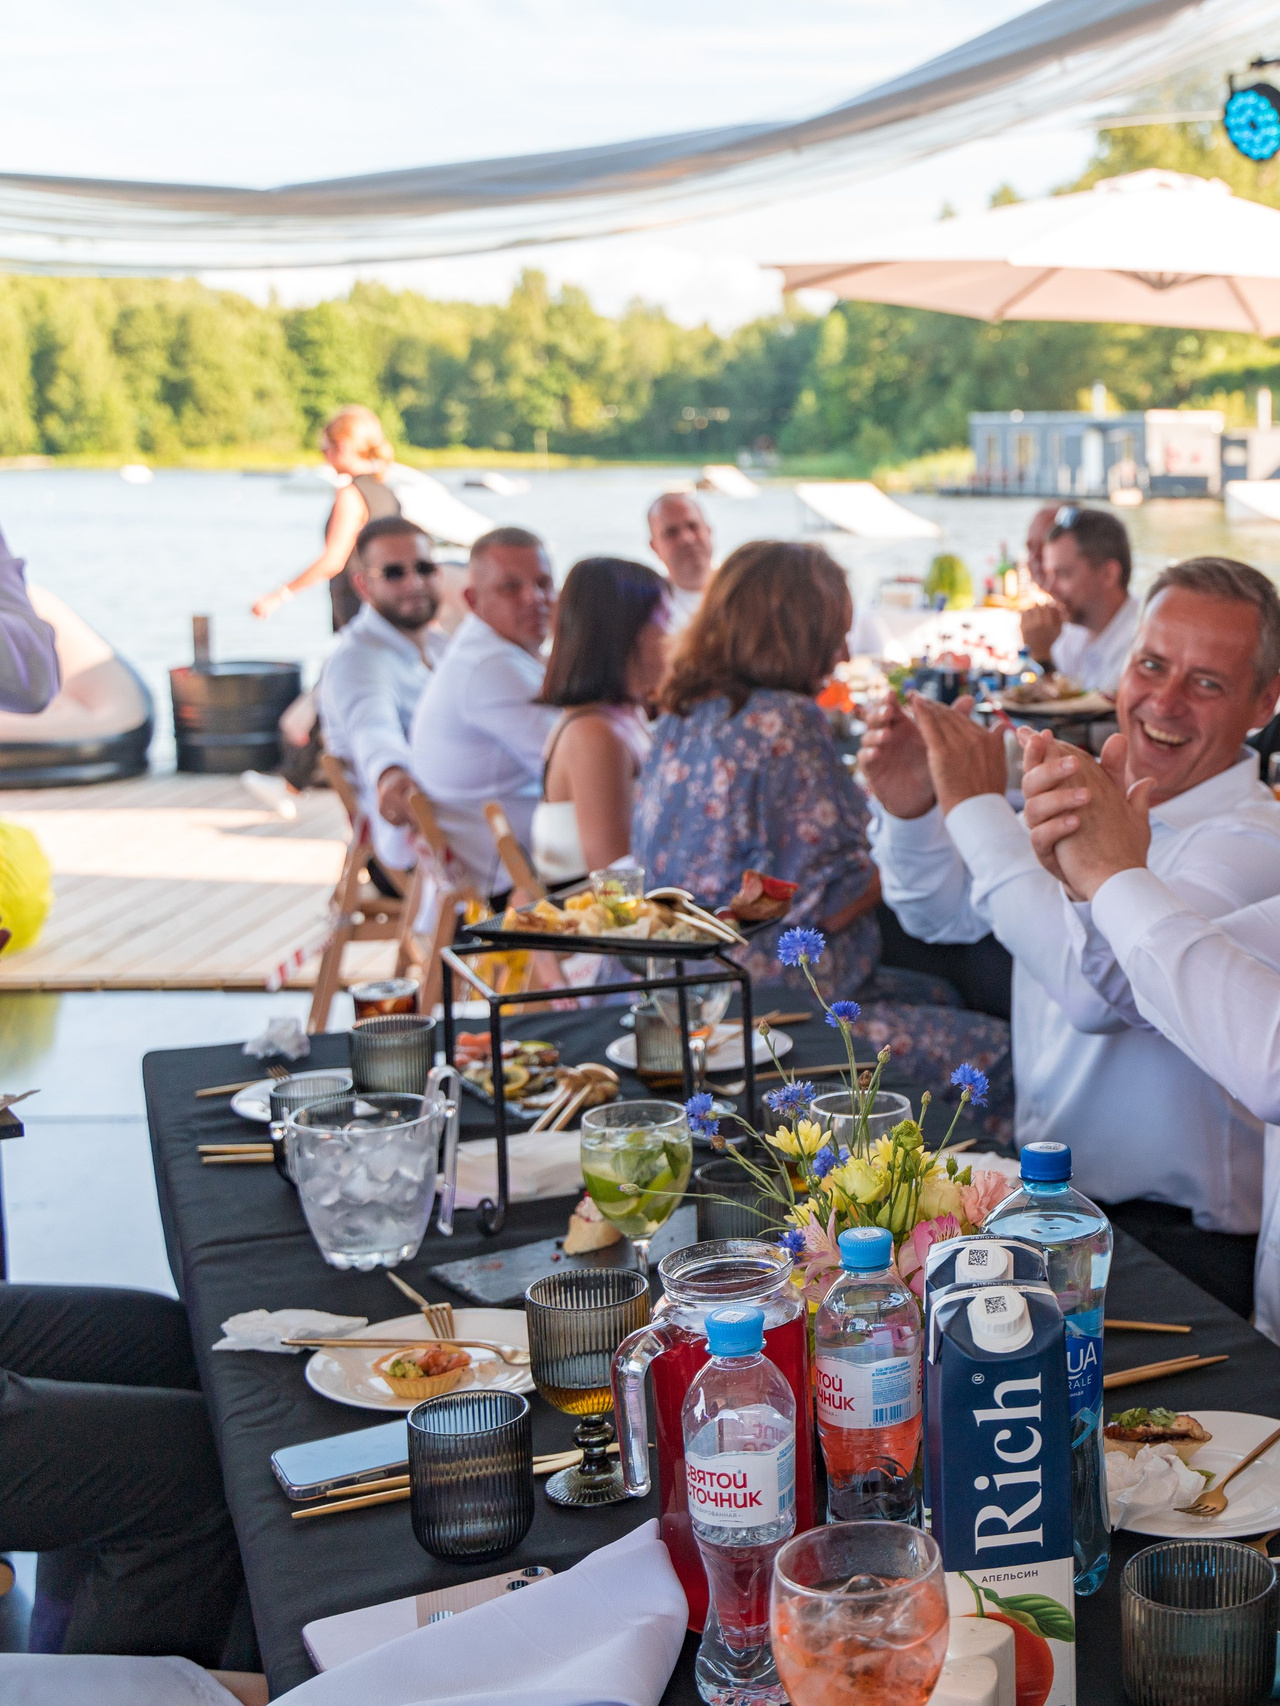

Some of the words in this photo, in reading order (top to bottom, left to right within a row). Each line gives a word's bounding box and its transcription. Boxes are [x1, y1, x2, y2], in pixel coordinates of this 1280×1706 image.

[1066, 1341, 1098, 1374] UA
[972, 1372, 1043, 1555] Rich
[981, 1569, 1039, 1583] АПЕЛЬСИН
